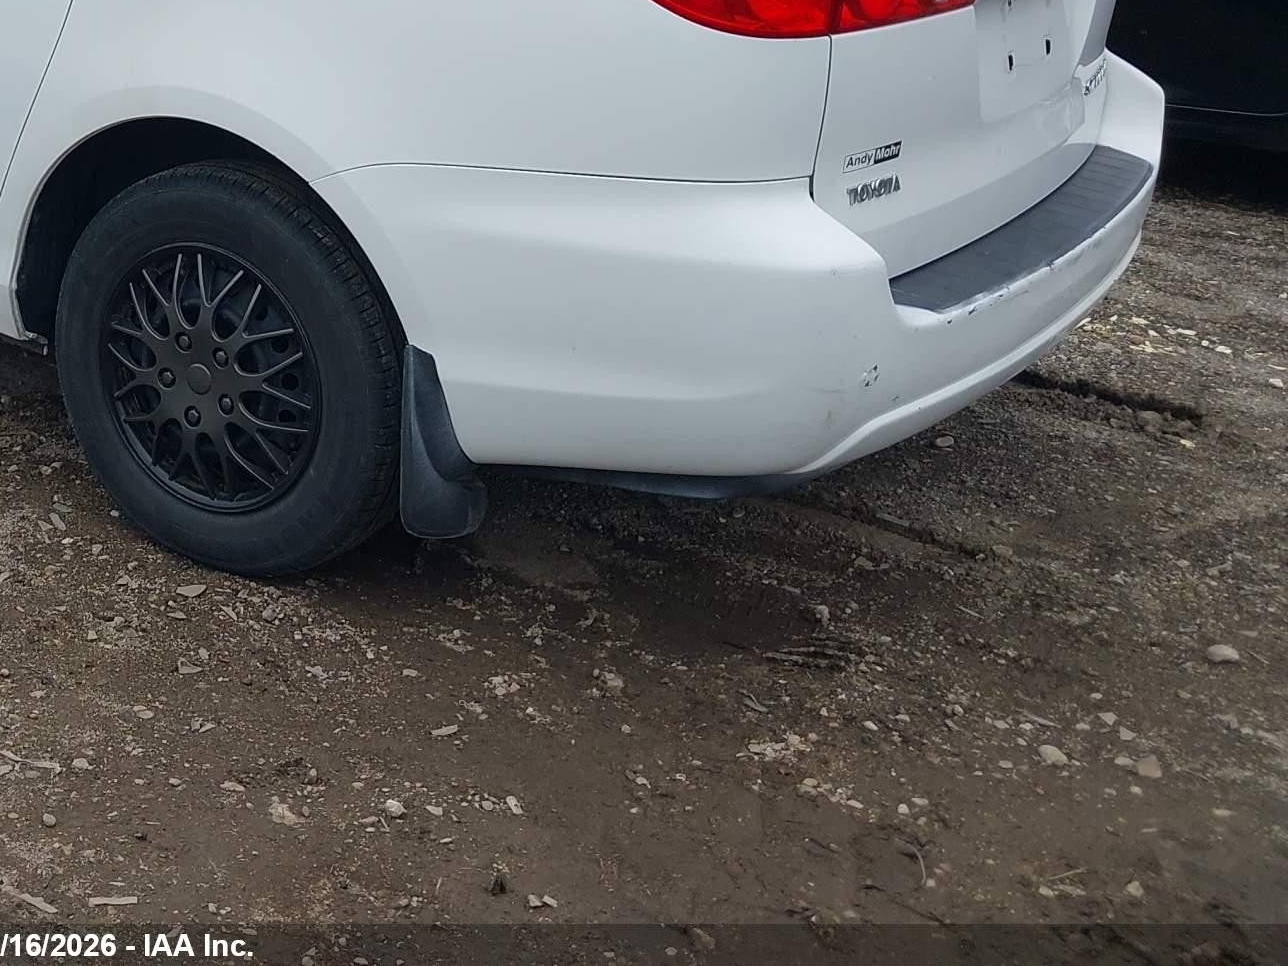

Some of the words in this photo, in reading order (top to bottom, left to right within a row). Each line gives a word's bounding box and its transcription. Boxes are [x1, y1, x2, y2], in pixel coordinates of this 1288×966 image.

[845, 152, 874, 169] Andy
[874, 144, 901, 161] Mohr
[846, 174, 901, 206] TOYOTA
